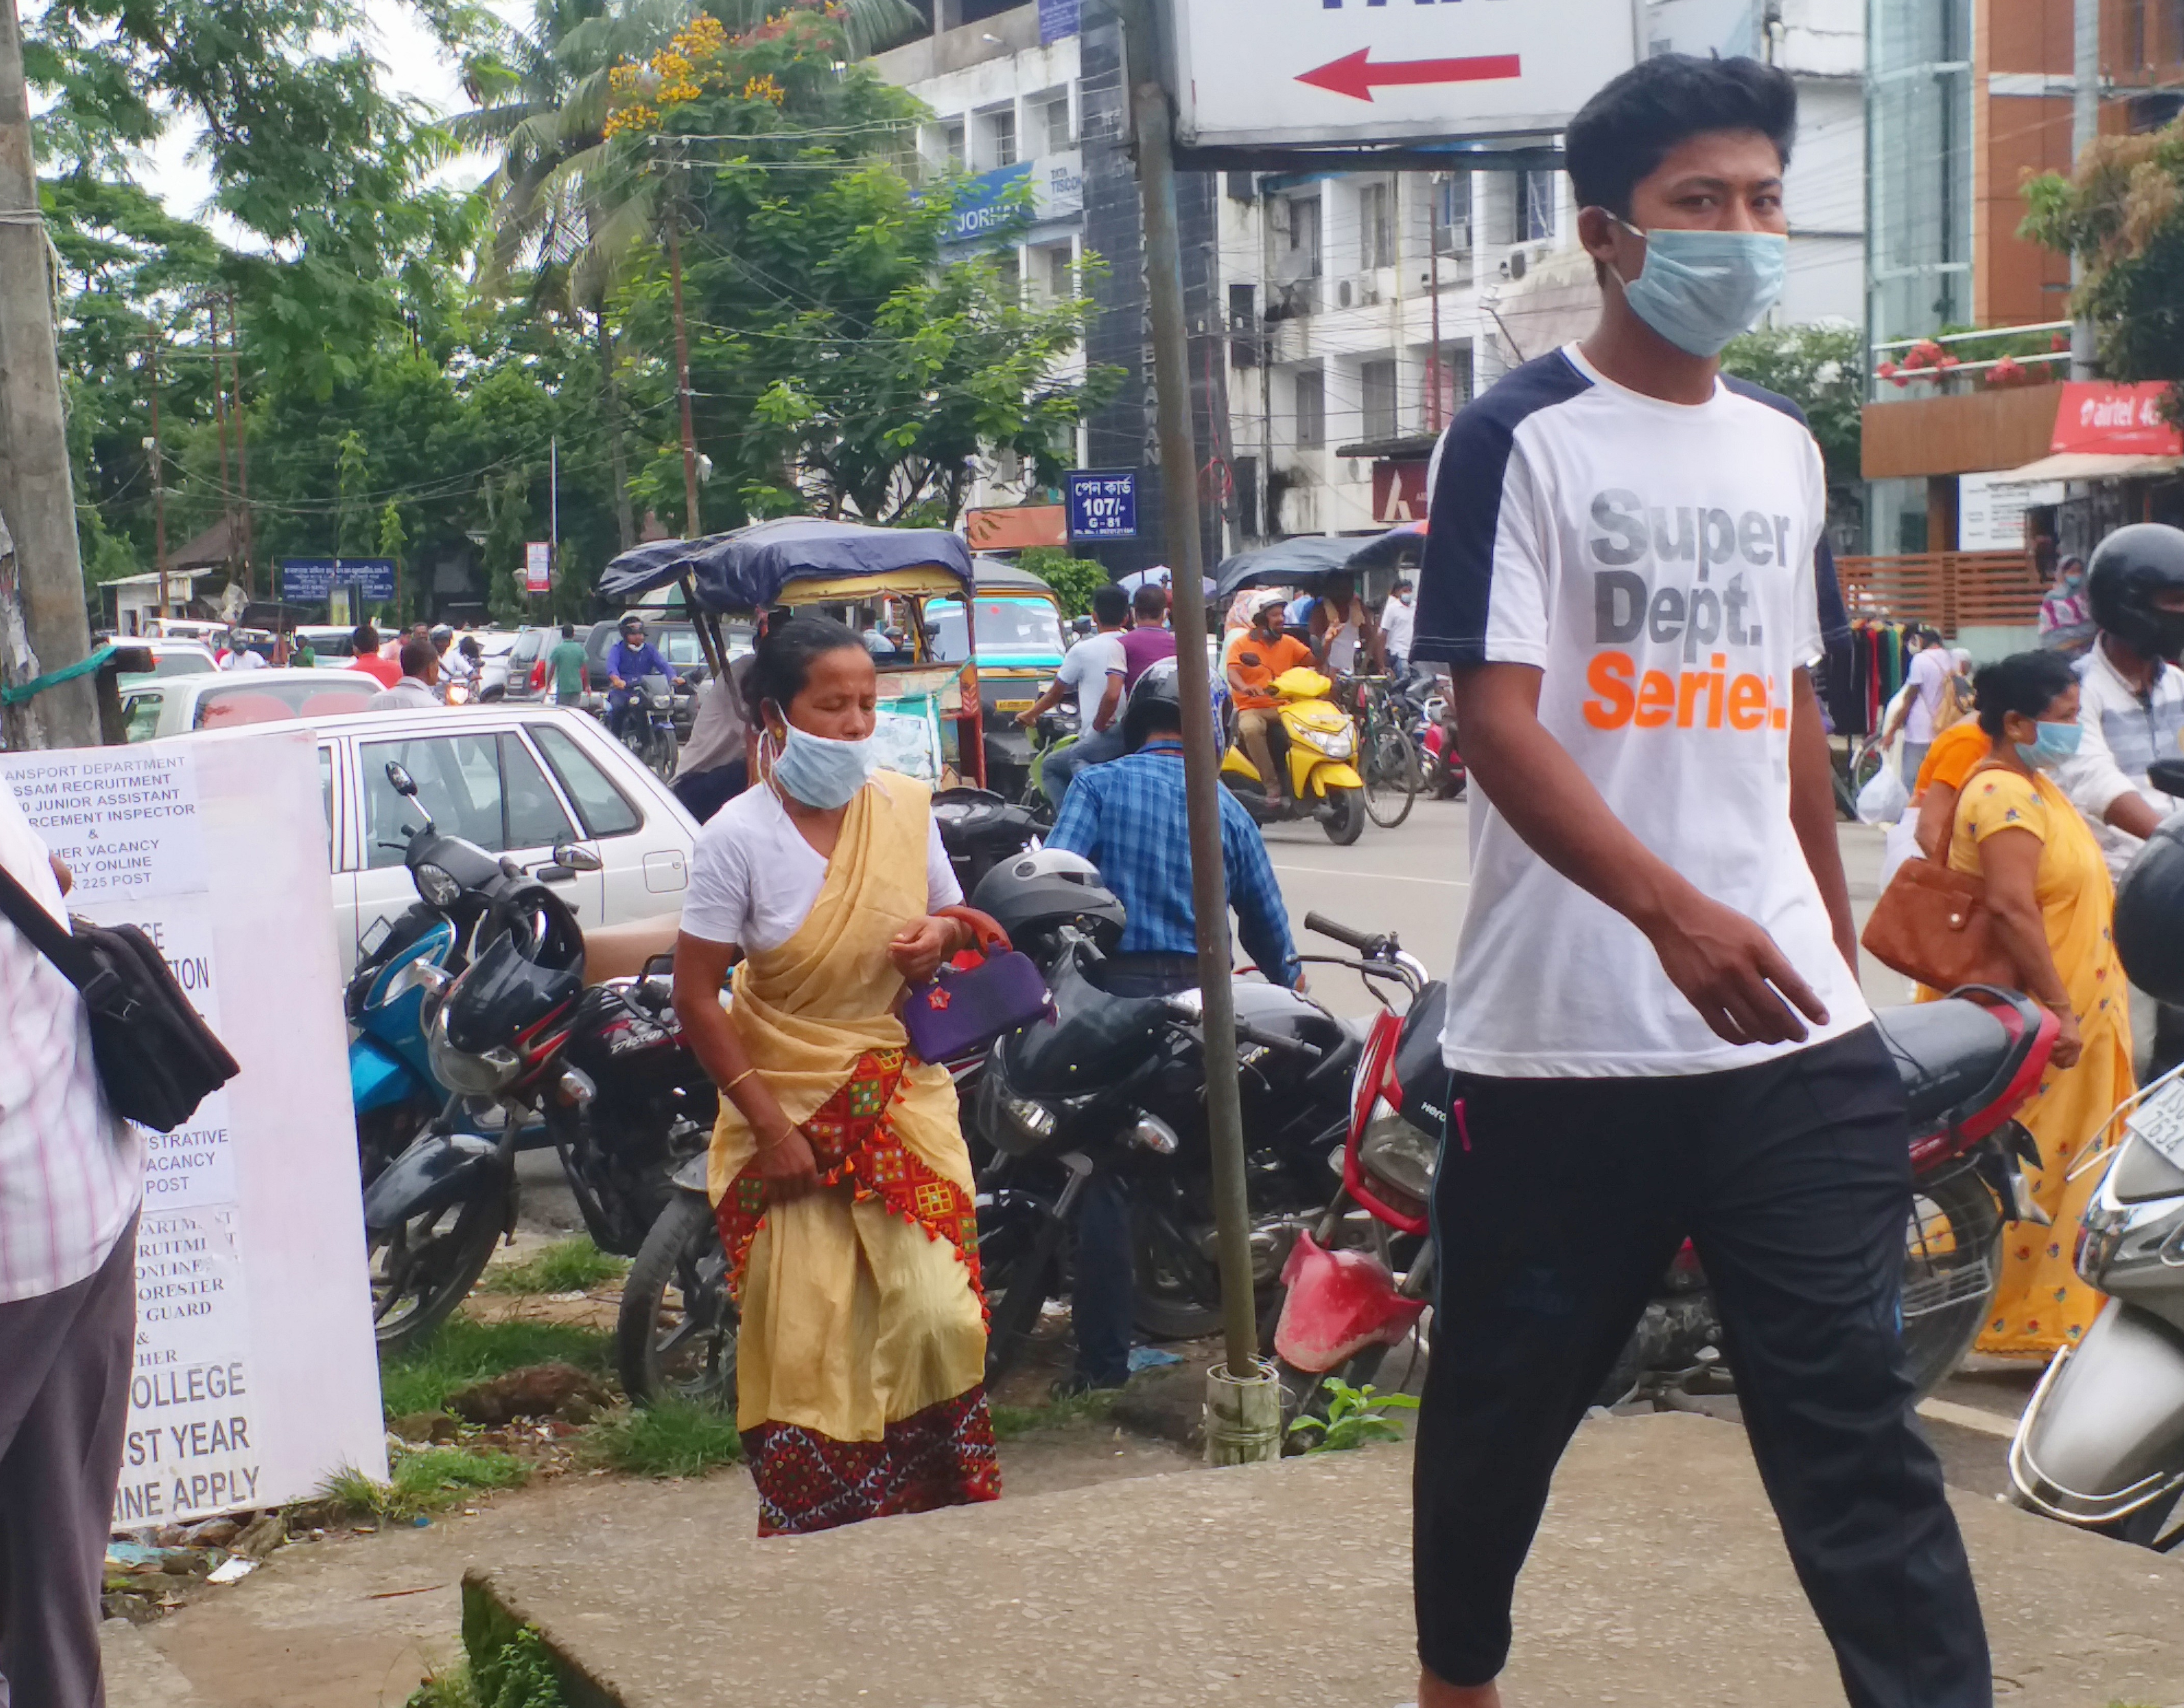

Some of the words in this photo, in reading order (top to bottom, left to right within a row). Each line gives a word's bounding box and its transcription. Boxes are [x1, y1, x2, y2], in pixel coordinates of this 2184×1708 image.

[1590, 488, 1790, 582] Super
[1594, 570, 1763, 663] Dept.
[1581, 651, 1787, 731] Serie.
[83, 756, 185, 775] DEPARTMENT
[63, 774, 172, 793] RECRUITMENT
[35, 797, 92, 812] JUNIOR
[97, 789, 180, 806] ASSISTANT
[108, 804, 196, 821] INSPECTOR
[89, 829, 99, 839] &
[87, 839, 160, 856] VACANCY
[96, 856, 153, 871] ONLINE
[83, 877, 108, 889] 225
[112, 872, 152, 886] POST
[145, 1129, 229, 1150] STRATIVE
[146, 1151, 215, 1172] ACANCY
[146, 1177, 189, 1194] POST
[146, 1301, 211, 1321] GUARD
[136, 1331, 150, 1345] &
[137, 1350, 178, 1367] HER
[170, 1416, 250, 1458] YEAR
[112, 1481, 163, 1522] INE
[173, 1466, 260, 1511] APPLY
